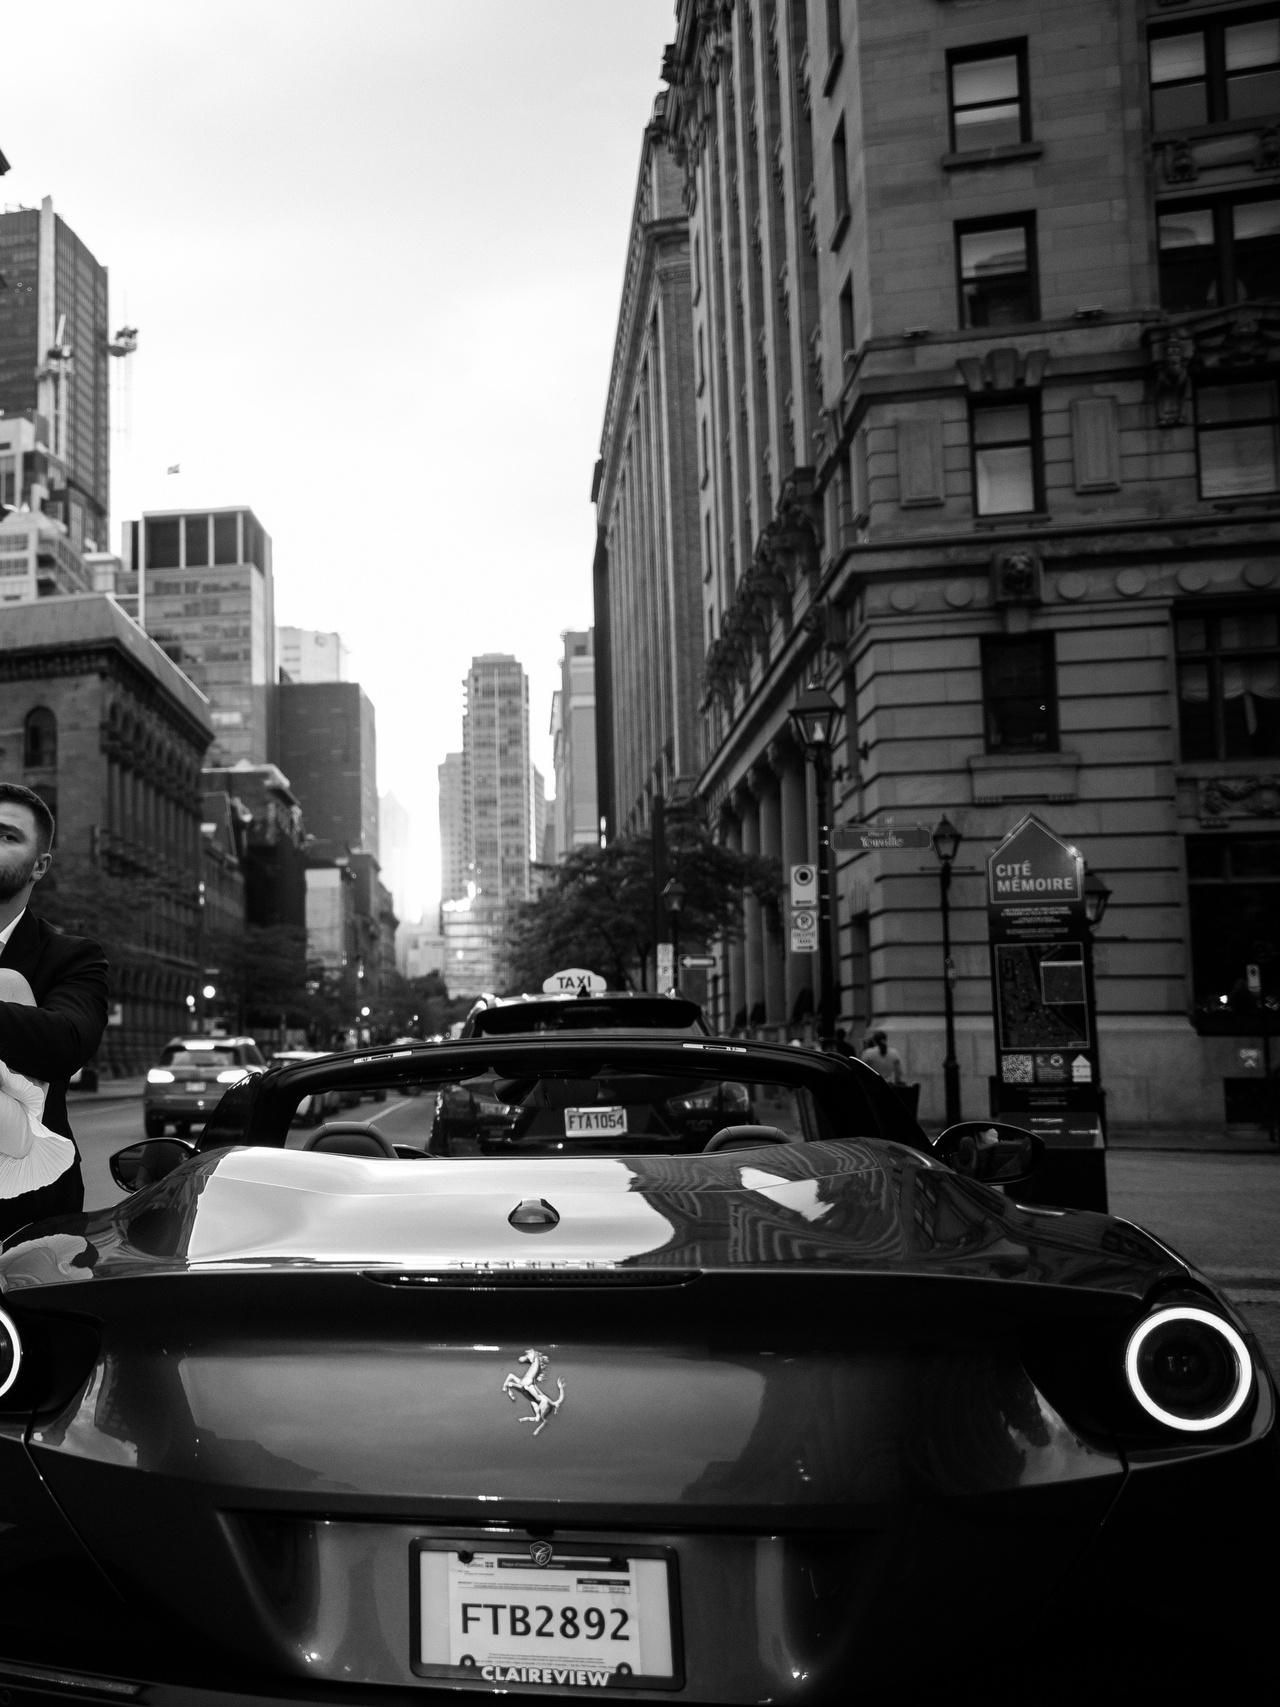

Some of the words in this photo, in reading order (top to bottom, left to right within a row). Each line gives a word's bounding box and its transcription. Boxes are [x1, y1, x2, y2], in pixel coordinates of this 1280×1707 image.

[995, 859, 1032, 877] CITÉ
[996, 876, 1074, 893] MÉMOIRE
[556, 975, 591, 989] TAXI
[569, 1113, 624, 1129] FTA1054
[461, 1602, 630, 1641] FTB2892
[481, 1665, 610, 1687] CLAIREVIEW
